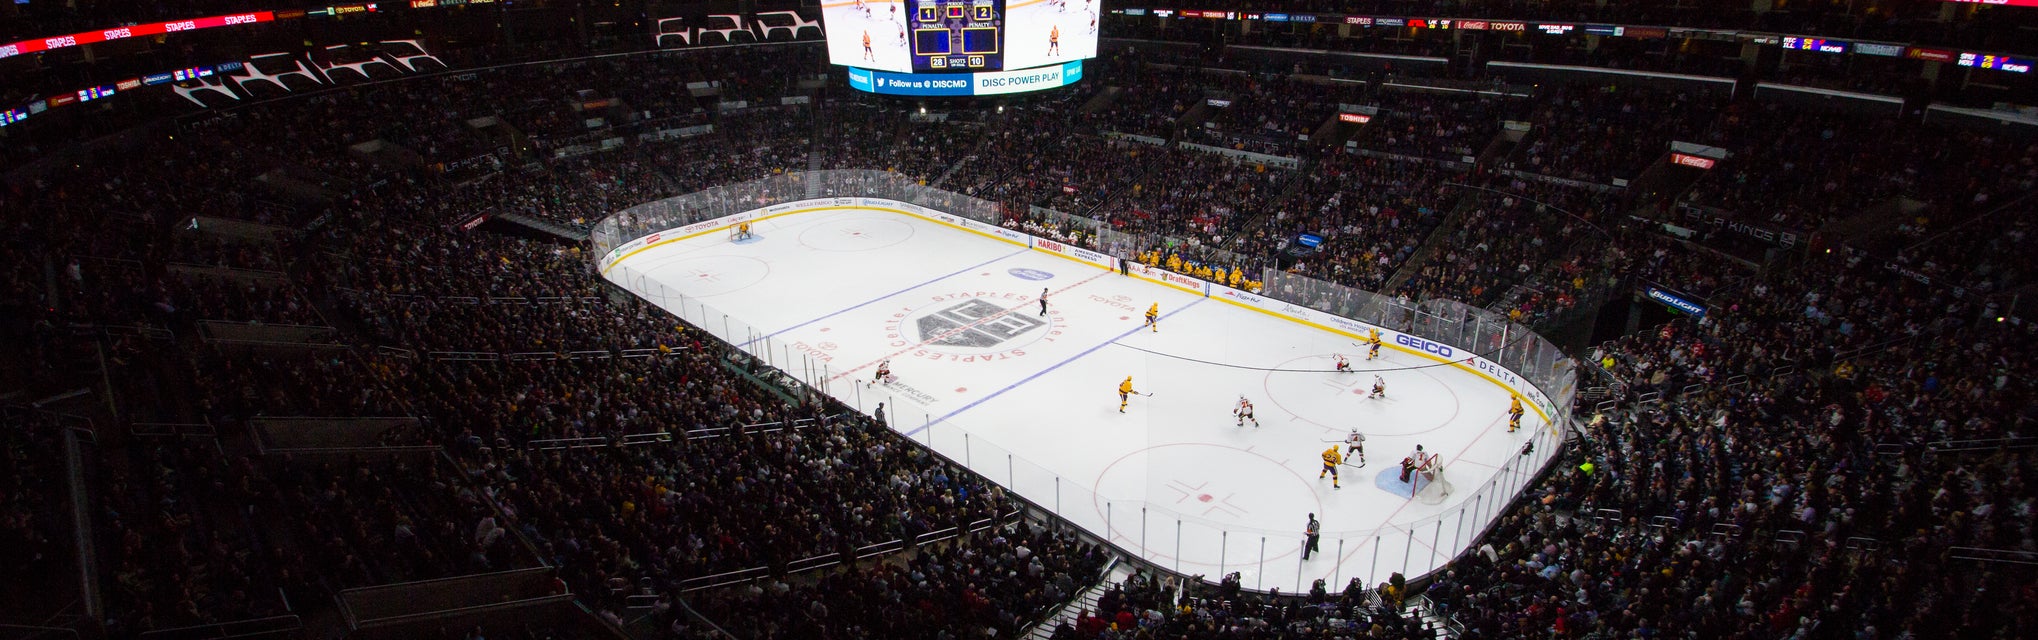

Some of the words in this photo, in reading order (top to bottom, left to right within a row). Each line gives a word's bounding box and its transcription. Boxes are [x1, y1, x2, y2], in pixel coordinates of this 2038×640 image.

[925, 9, 930, 18] 1
[980, 8, 987, 17] 2
[225, 14, 256, 25] STAPLES
[1347, 17, 1372, 25] STAPLES
[165, 20, 195, 33] STAPLES
[1490, 22, 1524, 31] TOYOTA
[104, 28, 131, 41] STAPLES
[46, 36, 76, 49] STAPLES
[117, 79, 141, 91] TOSHIBA
[889, 80, 911, 88] Follow
[932, 80, 967, 88] DISCMD
[982, 79, 1005, 87] DISC
[1009, 75, 1040, 85] POWER
[1042, 72, 1059, 82] PLAY
[1340, 114, 1370, 123] TOSHIBA
[695, 221, 719, 232] TOYOTA
[1728, 220, 1774, 241] KINGS
[1038, 239, 1061, 252] HARIBO
[1074, 253, 1097, 262] EXPRESS
[1075, 249, 1102, 259] AMERICAN
[1169, 274, 1199, 289] DraftKings
[932, 291, 1029, 303] STAPLES
[1088, 294, 1136, 312] TOYOTA
[1653, 290, 1674, 303] BUD
[1674, 298, 1702, 313] LIGHT
[1396, 334, 1452, 358] GEICO
[913, 349, 1026, 364] STAPLES
[1480, 361, 1516, 386] DELTA
[893, 380, 940, 403] MERCURY
